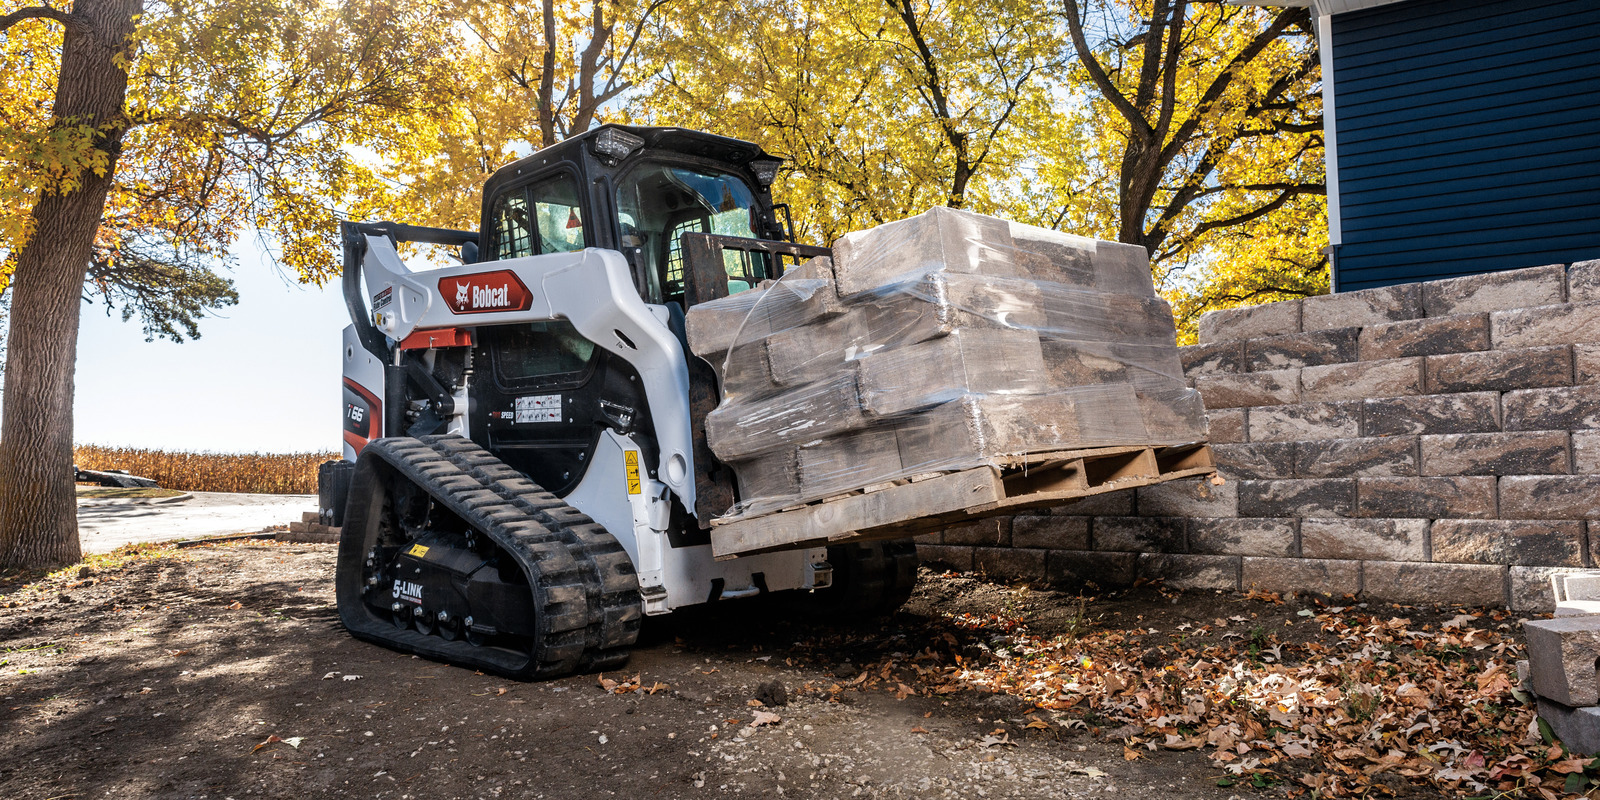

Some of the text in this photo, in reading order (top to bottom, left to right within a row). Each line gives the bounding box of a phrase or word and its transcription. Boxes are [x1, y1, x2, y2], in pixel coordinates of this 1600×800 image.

[472, 283, 509, 308] Bobcat
[501, 411, 514, 419] SPEED
[393, 579, 423, 599] 5-LINK
